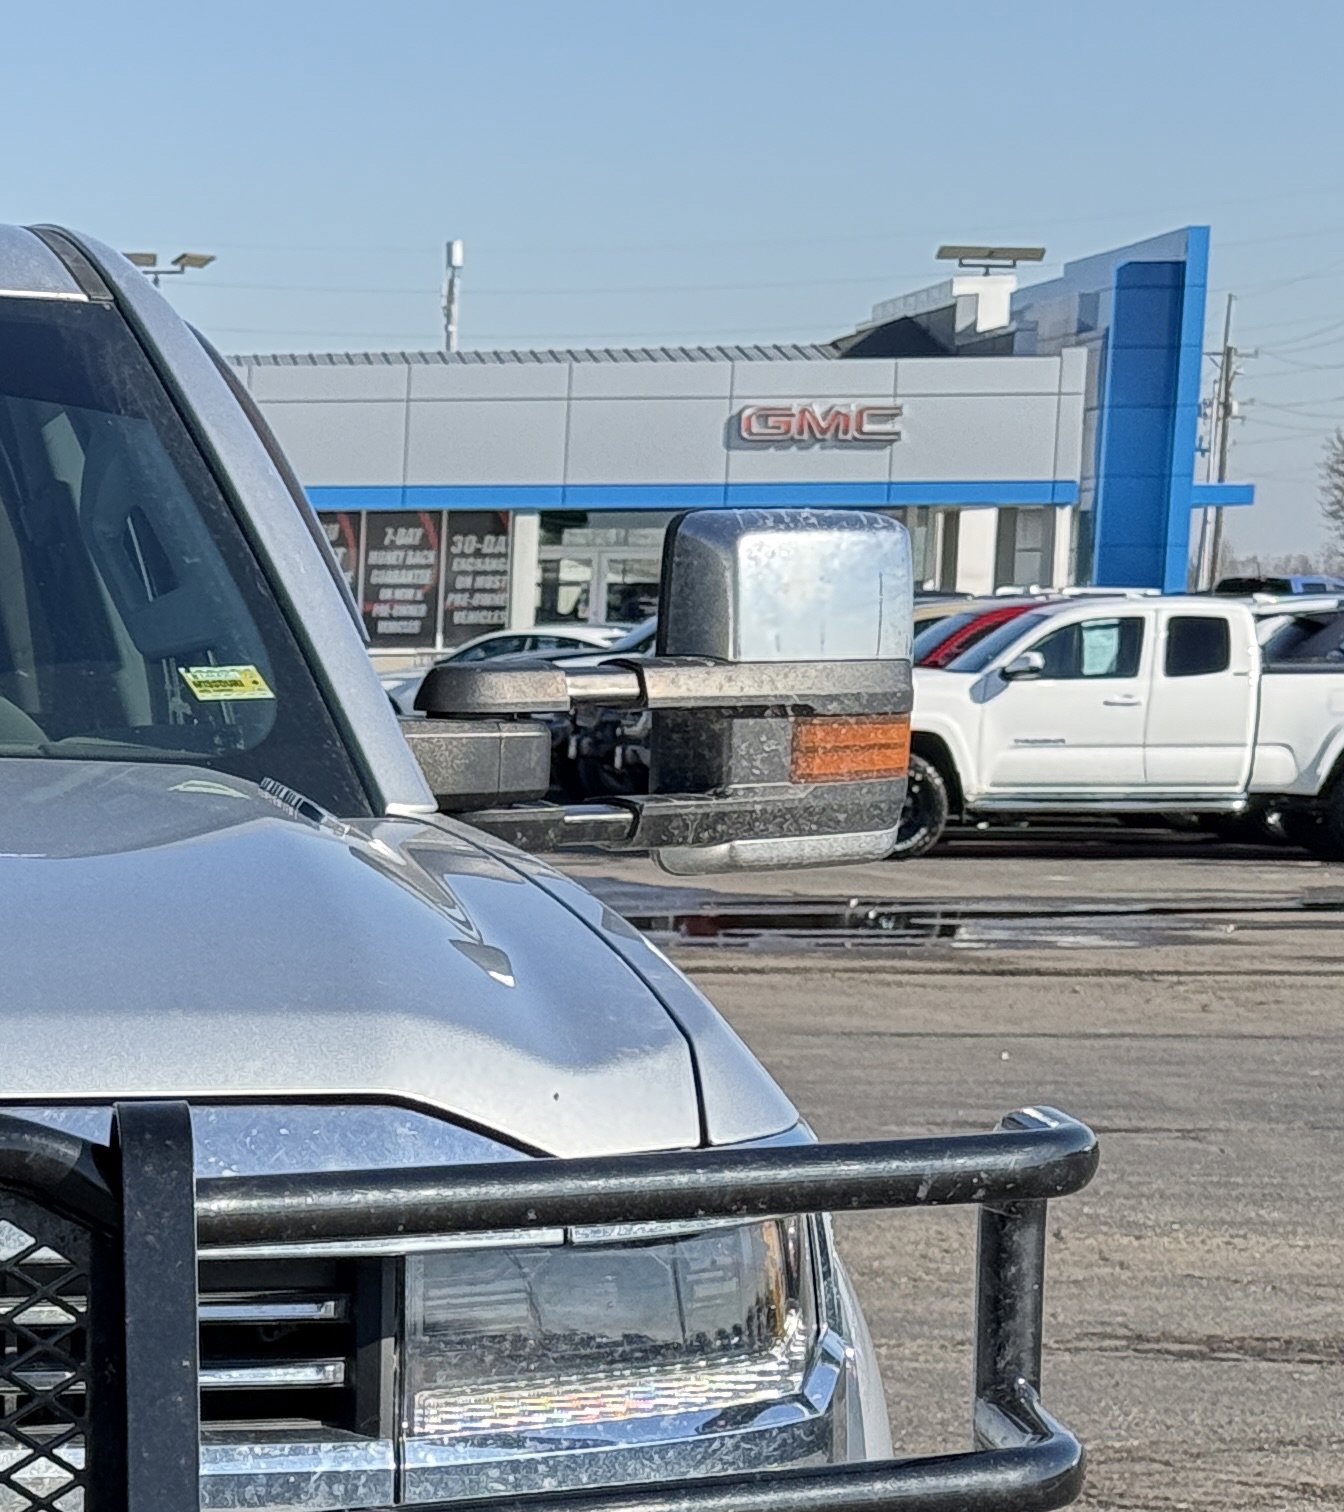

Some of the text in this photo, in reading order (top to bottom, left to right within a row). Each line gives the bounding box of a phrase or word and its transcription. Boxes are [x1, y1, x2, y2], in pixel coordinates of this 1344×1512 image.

[741, 404, 903, 441] GMC
[384, 527, 423, 545] 7-DAY
[450, 534, 507, 554] 30-DA
